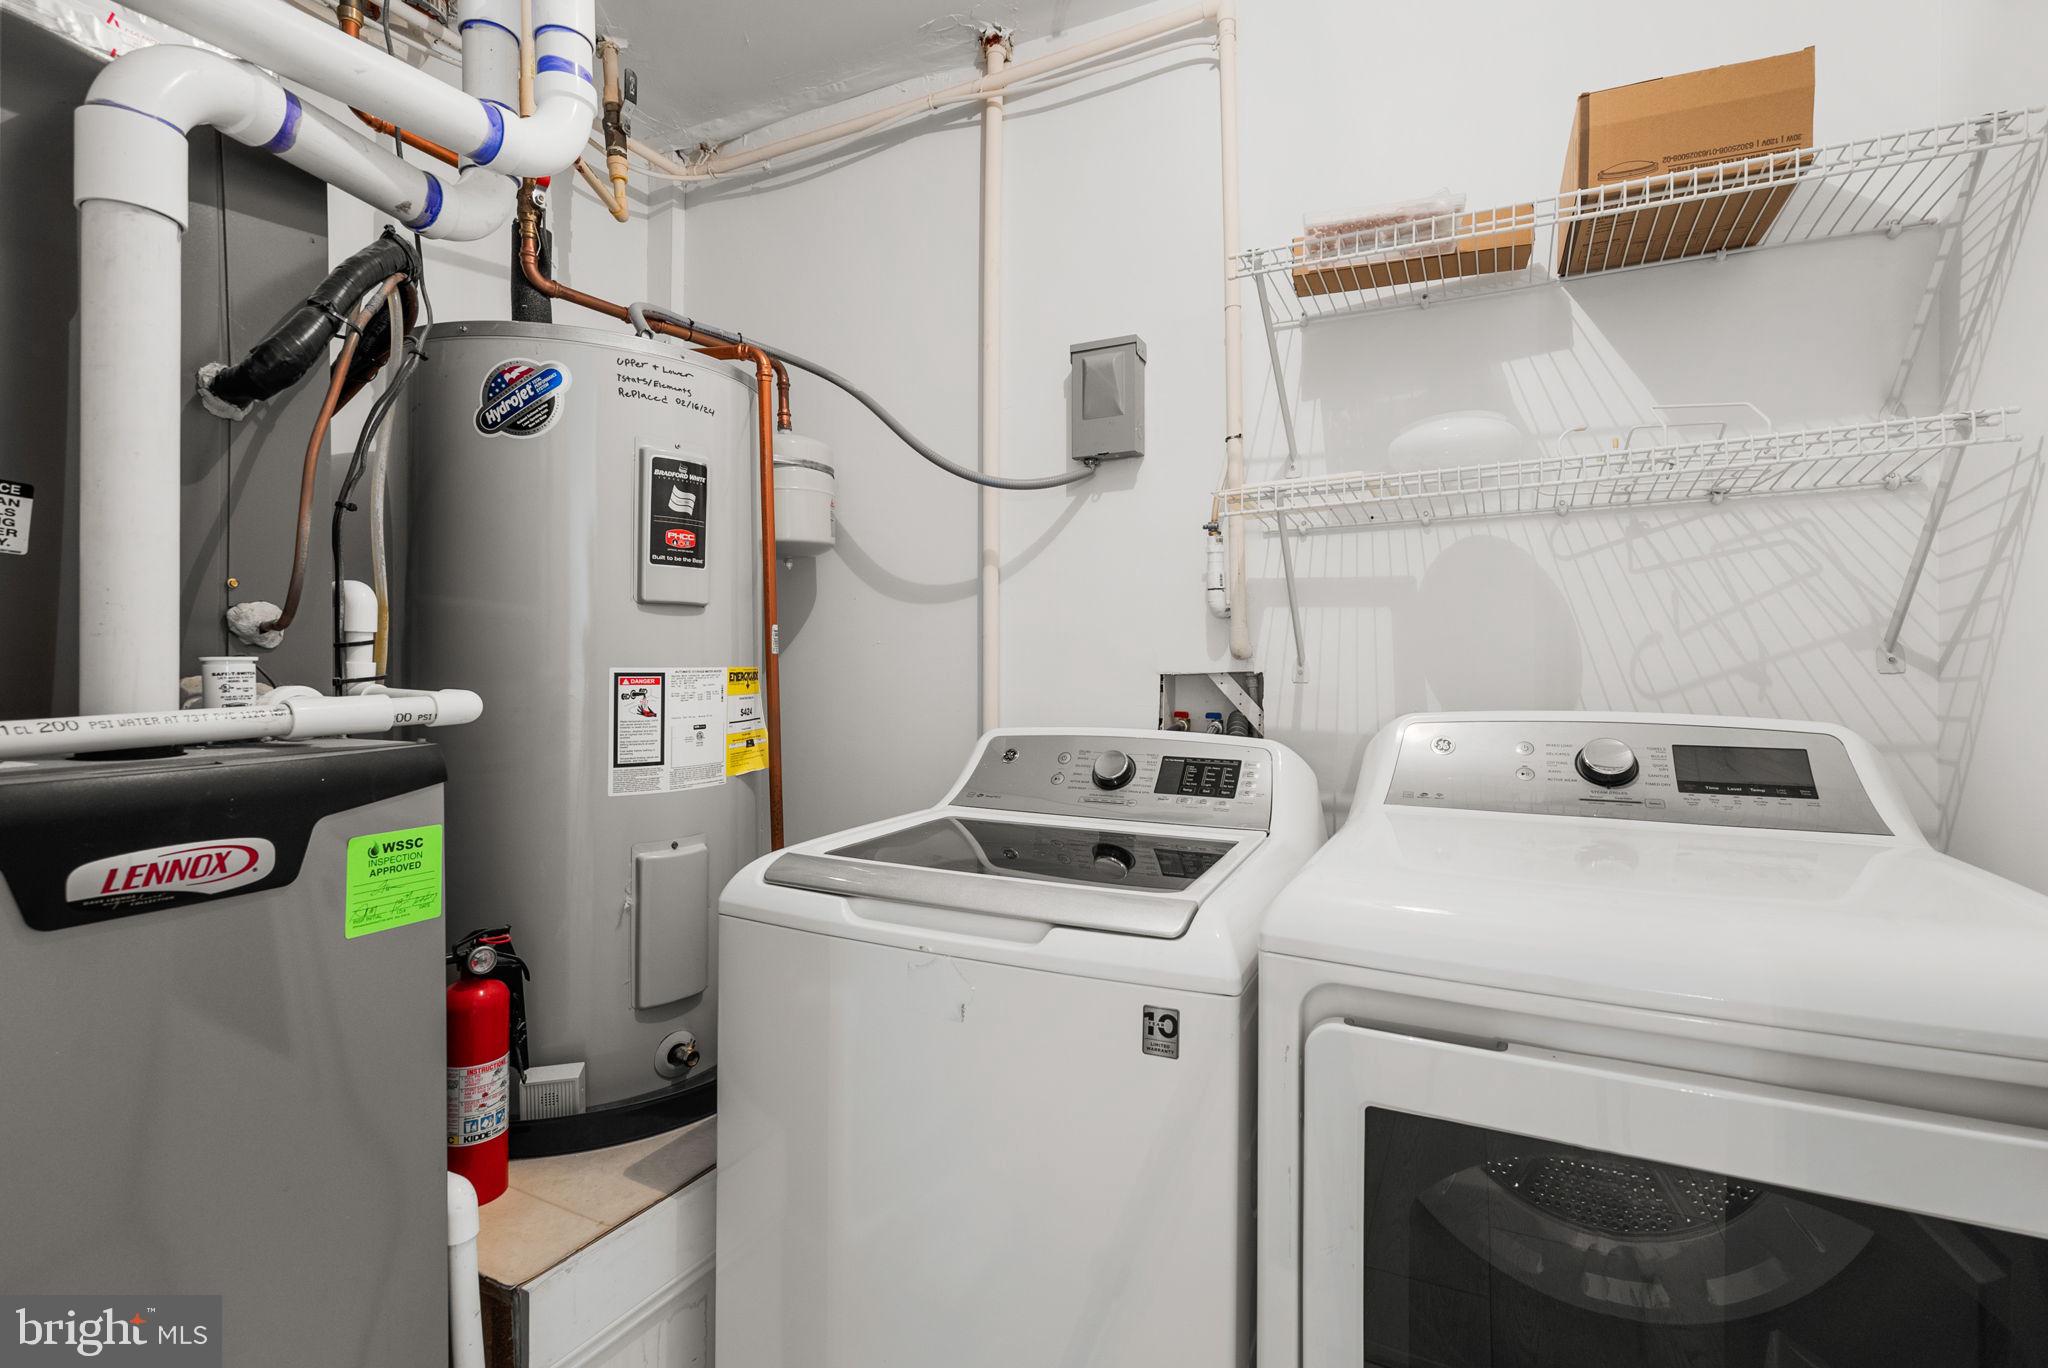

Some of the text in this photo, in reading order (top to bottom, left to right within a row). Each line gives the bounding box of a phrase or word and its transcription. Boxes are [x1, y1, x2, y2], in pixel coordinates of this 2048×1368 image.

[485, 383, 535, 425] Hydrojet
[654, 469, 706, 483] BRADFORD WHITE
[667, 532, 696, 541] PHCC
[14, 725, 33, 735] CL
[36, 720, 79, 733] 200
[88, 720, 114, 729] PSI
[117, 716, 160, 727] WATER
[164, 715, 180, 724] AT
[395, 712, 412, 723] 00
[382, 837, 424, 853] WSSC
[368, 851, 423, 867] INSPECTION
[101, 850, 232, 893] LENNOX
[369, 860, 422, 878] APPROVED
[1144, 1011, 1177, 1039] 10
[1146, 1047, 1175, 1055] WARRANTY
[463, 1131, 492, 1144] KIDDE
